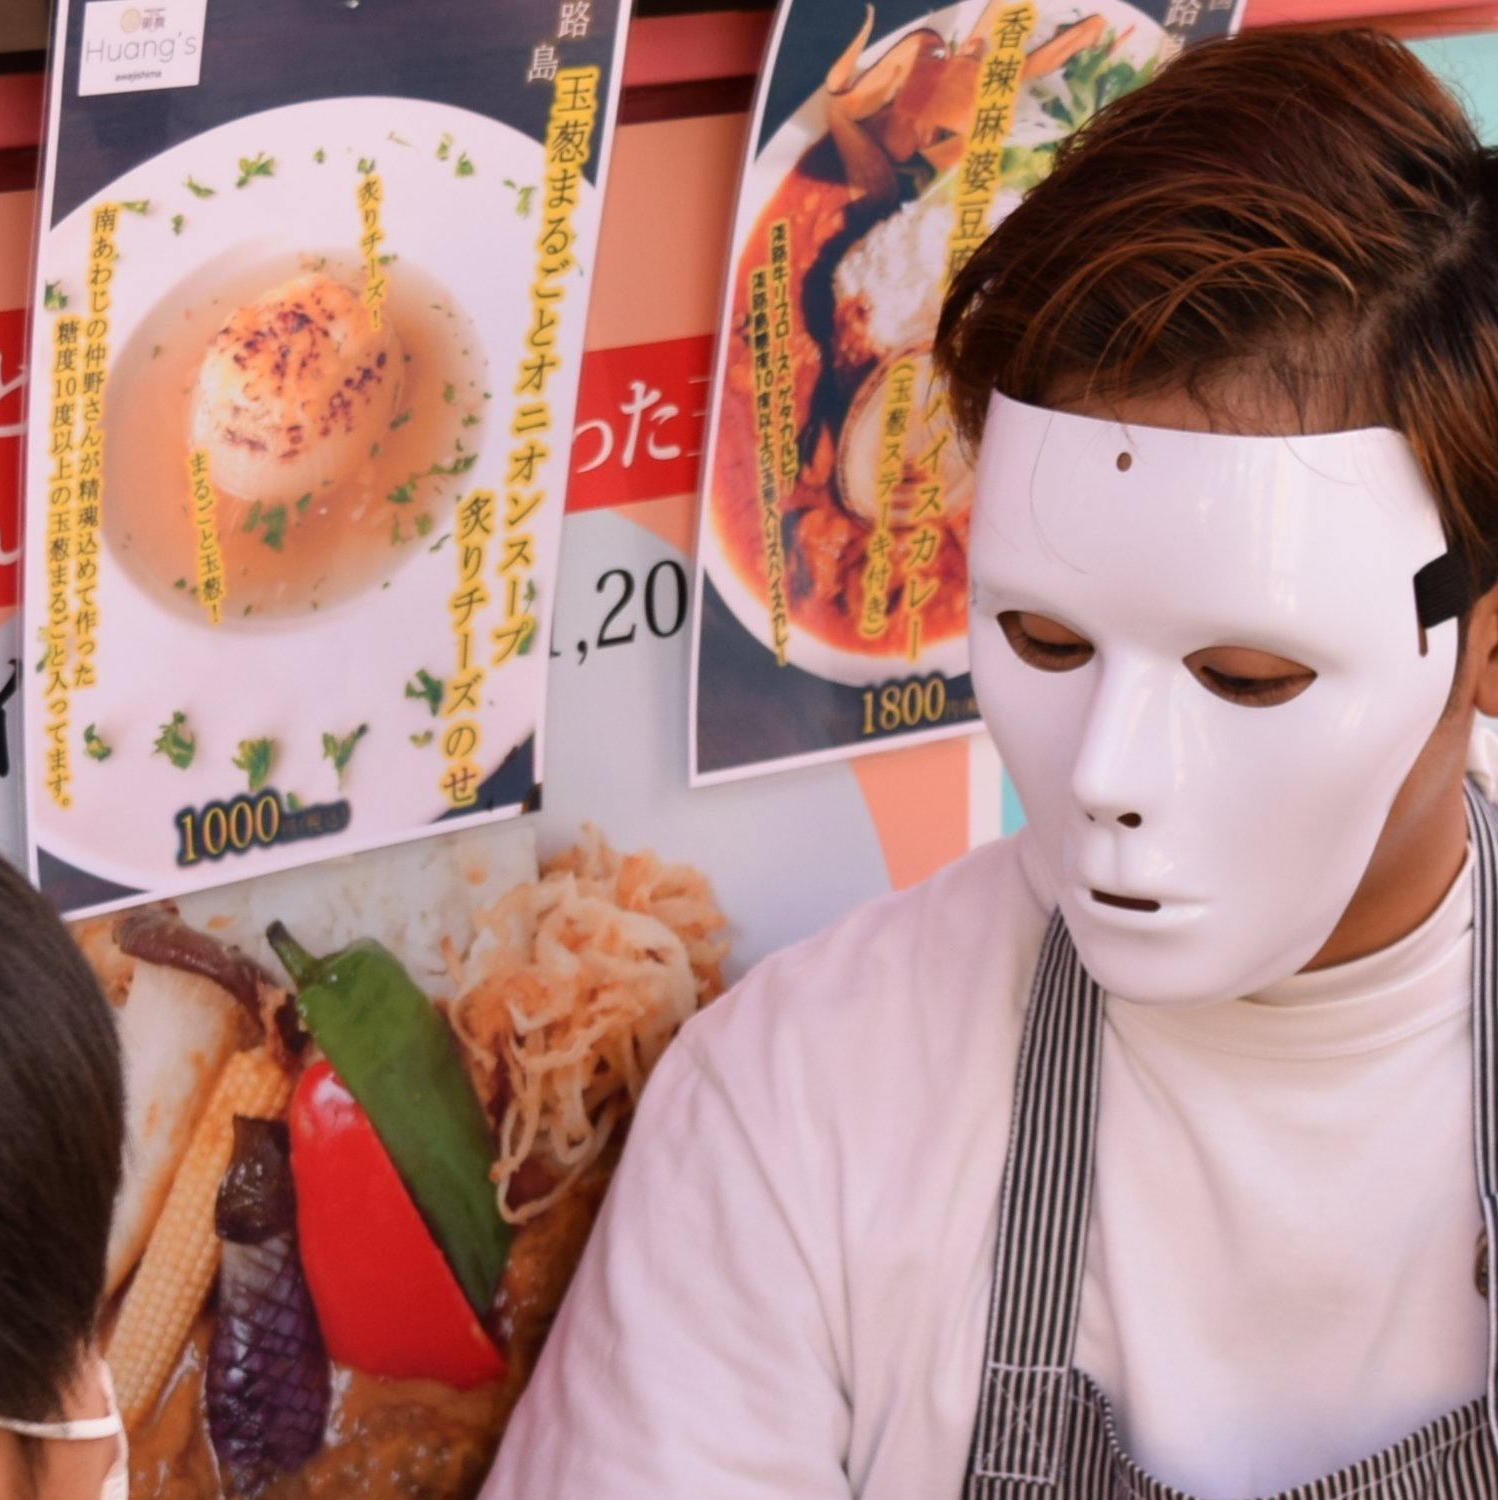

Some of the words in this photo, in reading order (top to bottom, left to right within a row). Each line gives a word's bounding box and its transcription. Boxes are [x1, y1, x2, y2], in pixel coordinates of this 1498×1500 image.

[85, 30, 198, 63] Huang's
[494, 72, 595, 663] 玉葱まるごとオニオンスープ
[443, 495, 491, 802] 炙りチーズのせ
[862, 676, 947, 735] 1800
[180, 795, 280, 863] 1000
